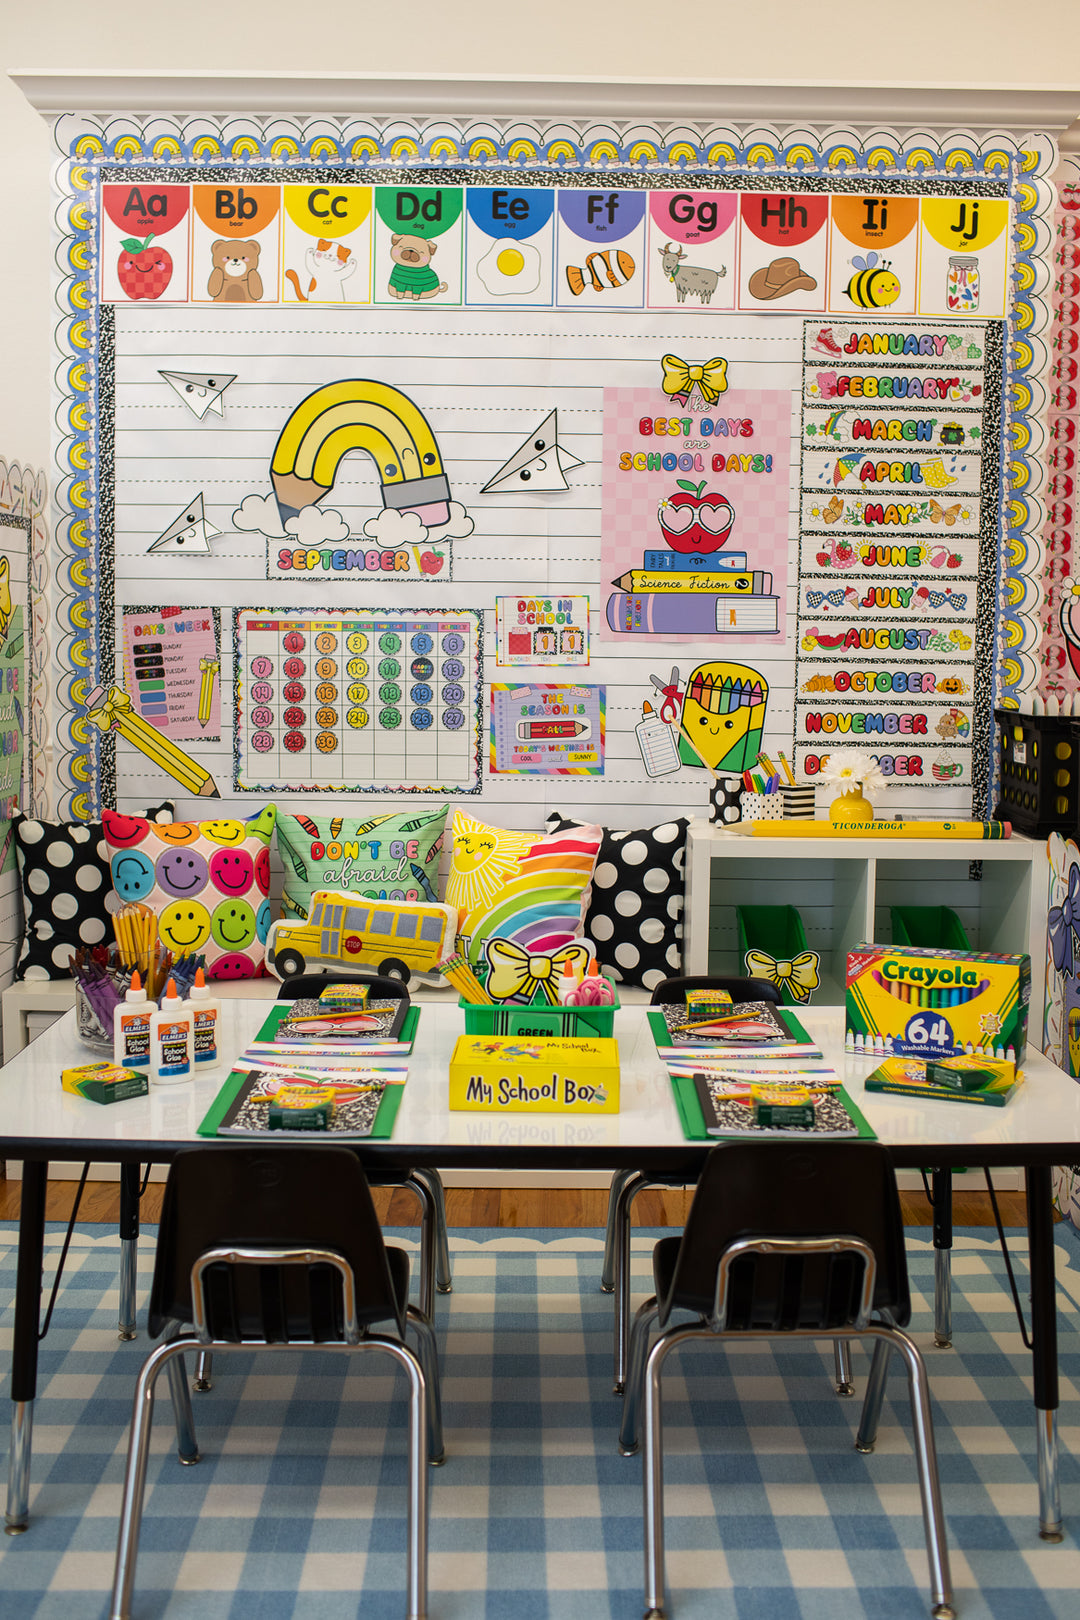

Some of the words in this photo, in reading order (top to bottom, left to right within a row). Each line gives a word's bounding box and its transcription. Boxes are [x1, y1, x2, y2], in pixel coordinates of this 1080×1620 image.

[123, 187, 167, 217] Aa
[215, 190, 258, 220] Bb
[307, 188, 348, 219] Cc
[396, 190, 442, 222] Dd
[492, 190, 530, 221] Ee
[587, 194, 619, 225] Ff
[668, 193, 717, 233] Gg
[761, 197, 808, 229] Hh
[862, 199, 887, 230] Ii
[136, 218, 154, 226] apple
[412, 222, 425, 230] dog
[951, 202, 980, 240] Jj
[685, 231, 701, 239] goat
[958, 240, 969, 248] jar
[844, 333, 948, 356] JANUARY
[837, 376, 951, 399] FEBRUARY
[688, 395, 711, 413] The
[639, 417, 693, 436] BEST
[700, 418, 754, 437] DAYS
[852, 418, 932, 441] MARCH
[683, 439, 711, 450] are
[619, 452, 705, 472] SCHOOL
[711, 454, 773, 473] DAYS!
[860, 461, 923, 483] APRIL
[865, 503, 912, 525] MAY
[277, 549, 410, 572] SEPTEMBER
[862, 545, 921, 567] JUNE
[639, 575, 682, 589] Science
[689, 576, 730, 590] Fiction
[862, 587, 913, 608] JULY
[517, 600, 552, 612] DAYS
[558, 600, 573, 612] IN
[625, 595, 633, 630] REALISTIC
[518, 612, 573, 625] SCHOOL
[133, 623, 166, 637] DAYS
[174, 620, 211, 633] WEEK
[291, 636, 298, 649] 1
[322, 637, 330, 649] 2
[353, 637, 361, 649] 3
[385, 637, 394, 650] 4
[417, 638, 426, 650] 5
[449, 638, 457, 650] 6
[541, 636, 549, 650] 1
[568, 635, 576, 650] 1
[844, 628, 931, 650] AUGUST
[163, 643, 182, 651] SUNDAY
[164, 655, 184, 663] MONDAY
[165, 667, 187, 675] TUESDAY
[258, 661, 266, 674] 7
[290, 662, 299, 675] 8
[322, 662, 331, 674] 9
[351, 662, 365, 675] 10
[384, 662, 397, 675] 11
[446, 663, 460, 676] 13
[6, 667, 19, 693] BE
[834, 671, 937, 693] OCTOBER
[168, 691, 194, 699] THURSDAY
[255, 686, 269, 699] 14
[287, 686, 301, 699] 15
[319, 686, 333, 699] 16
[352, 687, 365, 699] 17
[383, 688, 397, 700] 18
[415, 688, 429, 701] 19
[446, 688, 460, 701] 20
[541, 693, 564, 704] THE
[520, 704, 569, 716] SEASON
[573, 704, 586, 715] IS
[255, 711, 269, 723] 21
[287, 711, 301, 723] 22
[319, 711, 334, 723] 23
[350, 711, 365, 724] 24
[383, 712, 397, 725] 25
[414, 712, 429, 725] 26
[446, 712, 461, 725] 27
[805, 712, 928, 735] NOVEMBER
[542, 725, 563, 734] FALL
[254, 735, 270, 747] 28
[286, 735, 301, 747] 29
[318, 735, 335, 748] 30
[513, 745, 546, 753] TODAY'S
[548, 744, 584, 752] WEATHER
[586, 743, 595, 751] IS
[831, 822, 904, 830] TICONDEROGA
[310, 841, 382, 861] DON'T
[389, 840, 420, 859] BE
[323, 855, 409, 888] afraid
[882, 960, 978, 986] Crayola
[194, 1020, 214, 1028] LMER'S
[162, 1033, 187, 1041] ELMER'S
[517, 1027, 554, 1037] GREEN
[908, 1018, 950, 1046] 64
[127, 1038, 149, 1047] School
[164, 1047, 186, 1056] School
[931, 1046, 955, 1056] Markers
[166, 1054, 182, 1062] Glue
[467, 1076, 492, 1104] My
[498, 1074, 558, 1105] School
